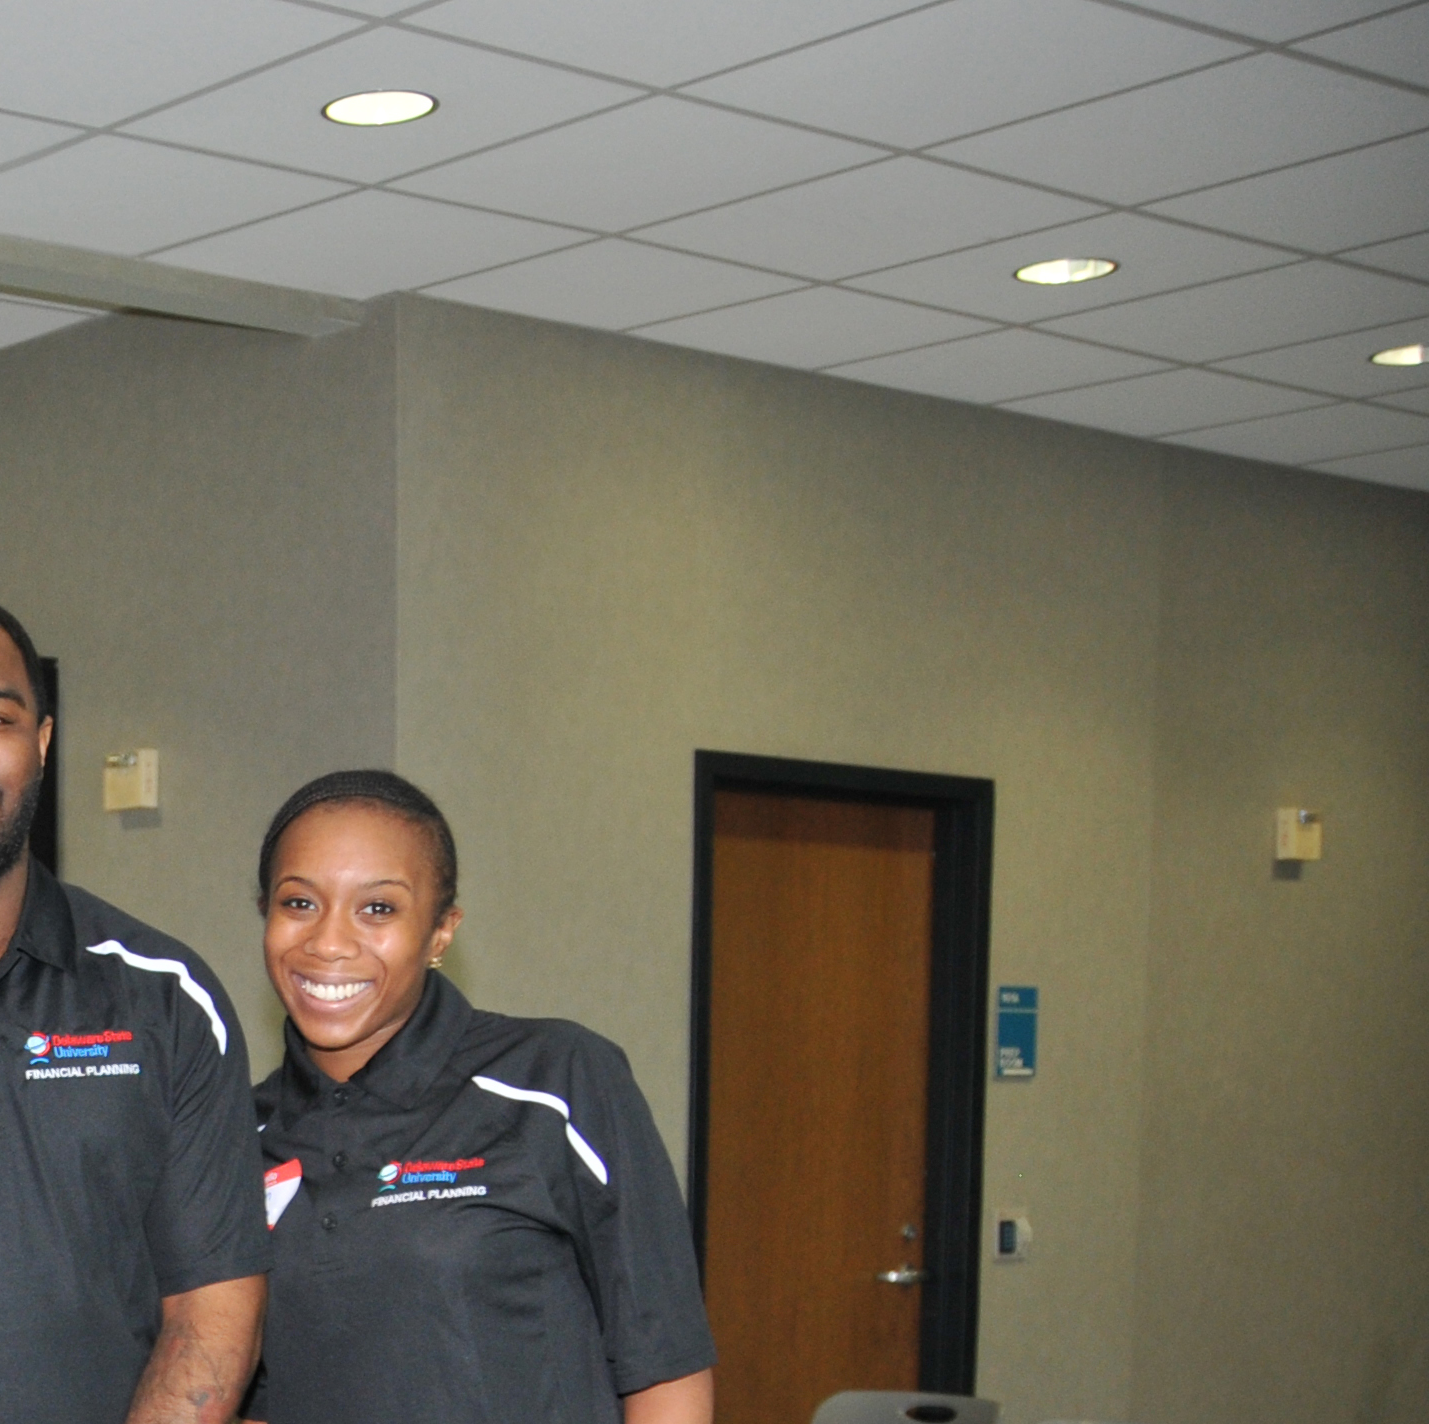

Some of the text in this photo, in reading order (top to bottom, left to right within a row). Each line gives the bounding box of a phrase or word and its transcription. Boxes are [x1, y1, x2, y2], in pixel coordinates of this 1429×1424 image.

[54, 1044, 110, 1059] University
[25, 1063, 140, 1080] FINANCIAL PLANNING
[401, 1170, 457, 1184] University
[371, 1185, 488, 1208] FINANCIAL PLANNING
